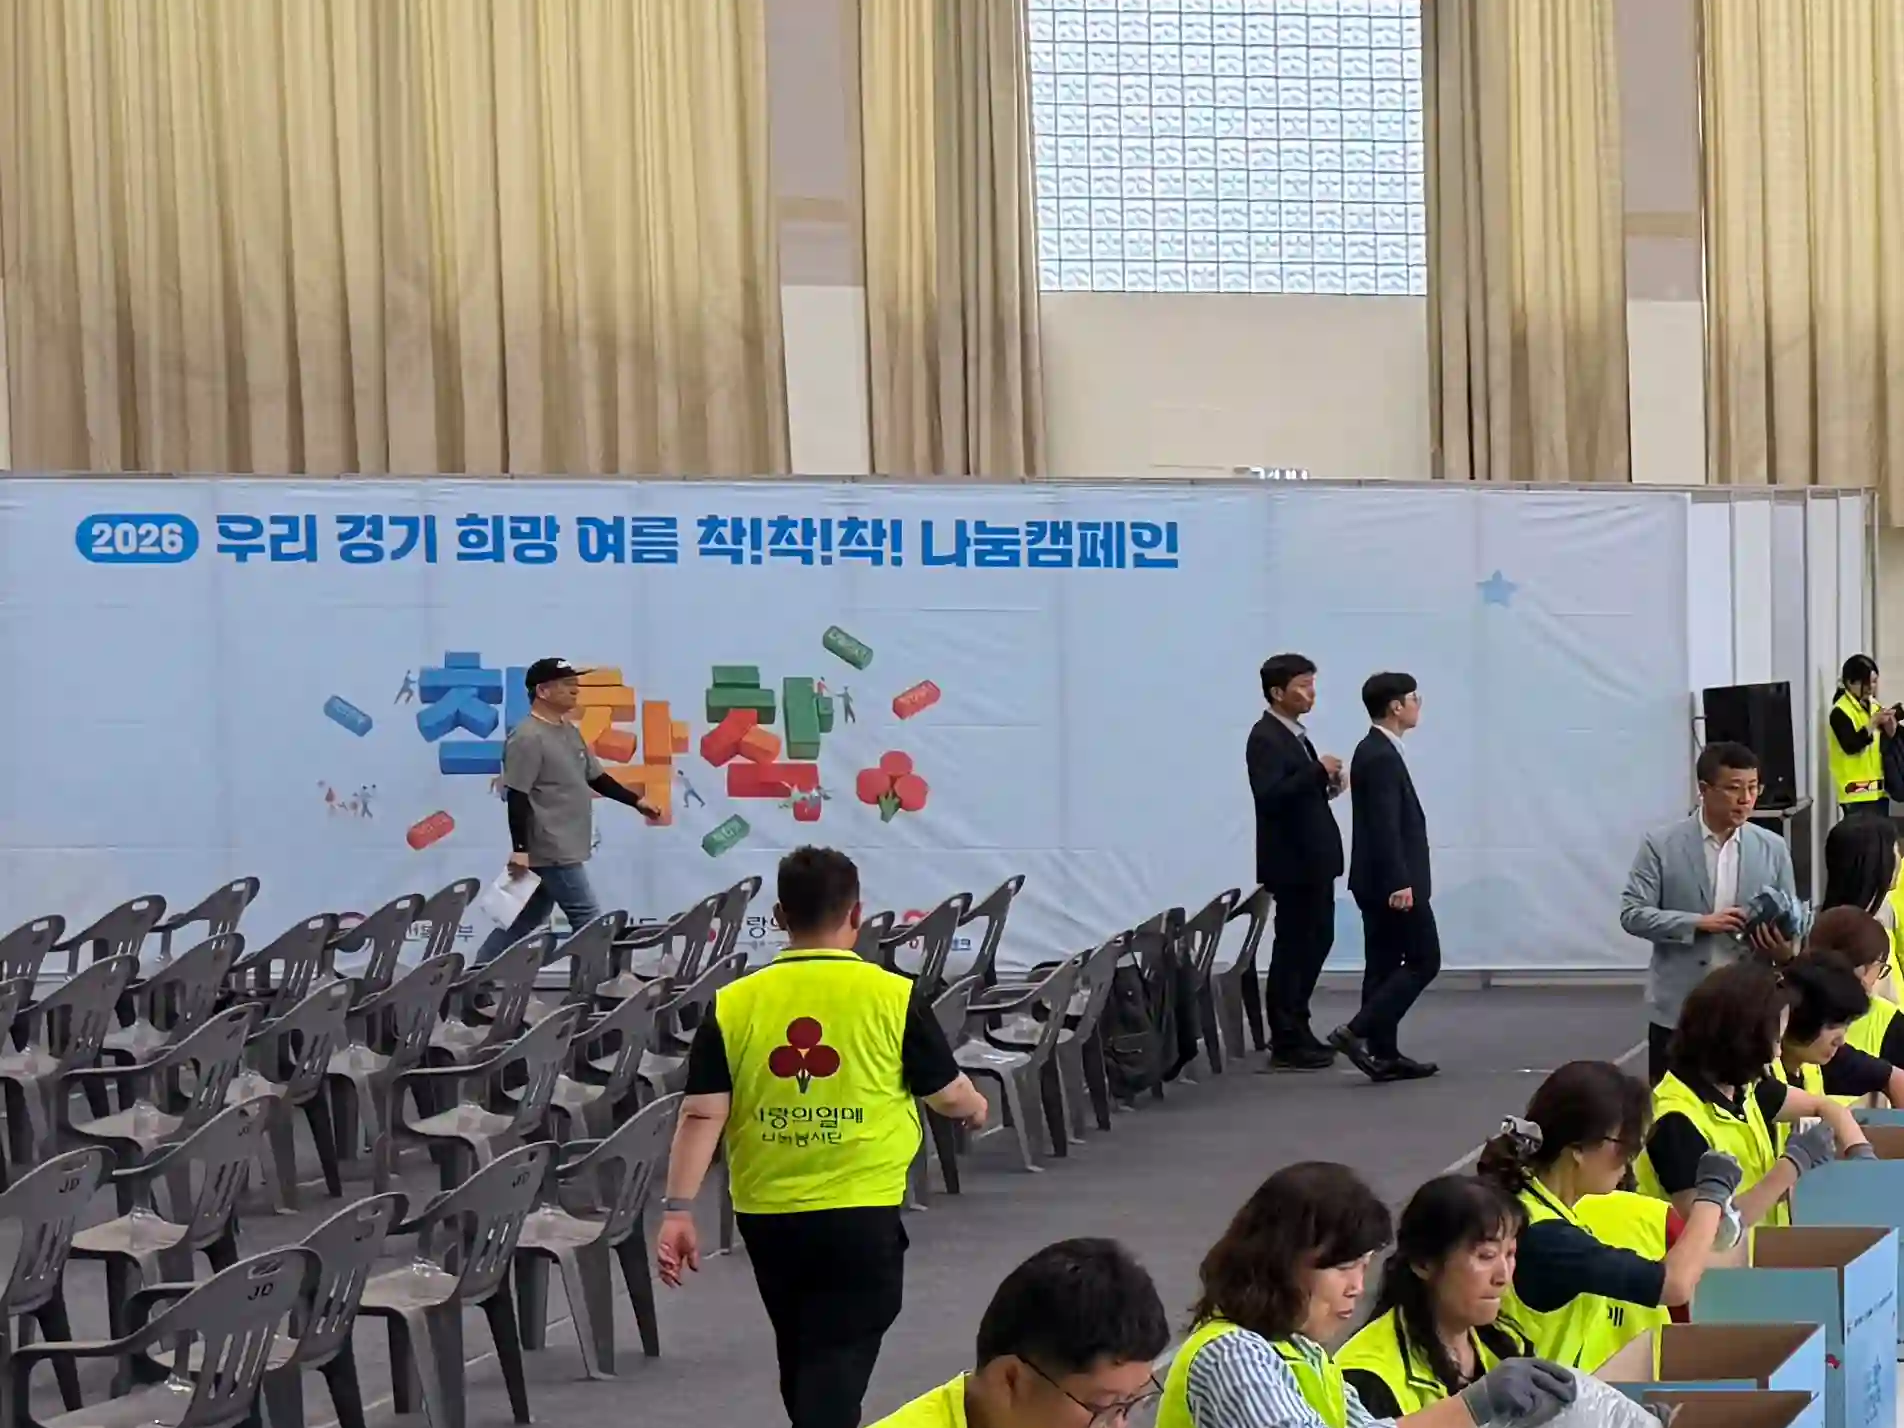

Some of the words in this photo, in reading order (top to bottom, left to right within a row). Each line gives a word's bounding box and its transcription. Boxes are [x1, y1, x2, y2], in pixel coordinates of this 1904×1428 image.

[91, 522, 185, 555] 2026
[216, 513, 318, 563] 우리
[336, 513, 438, 564] 경기
[456, 513, 560, 564] 희망
[576, 515, 678, 565] 여름
[697, 514, 903, 567] 착!착!착!
[921, 518, 1179, 569] 나눔캠페인
